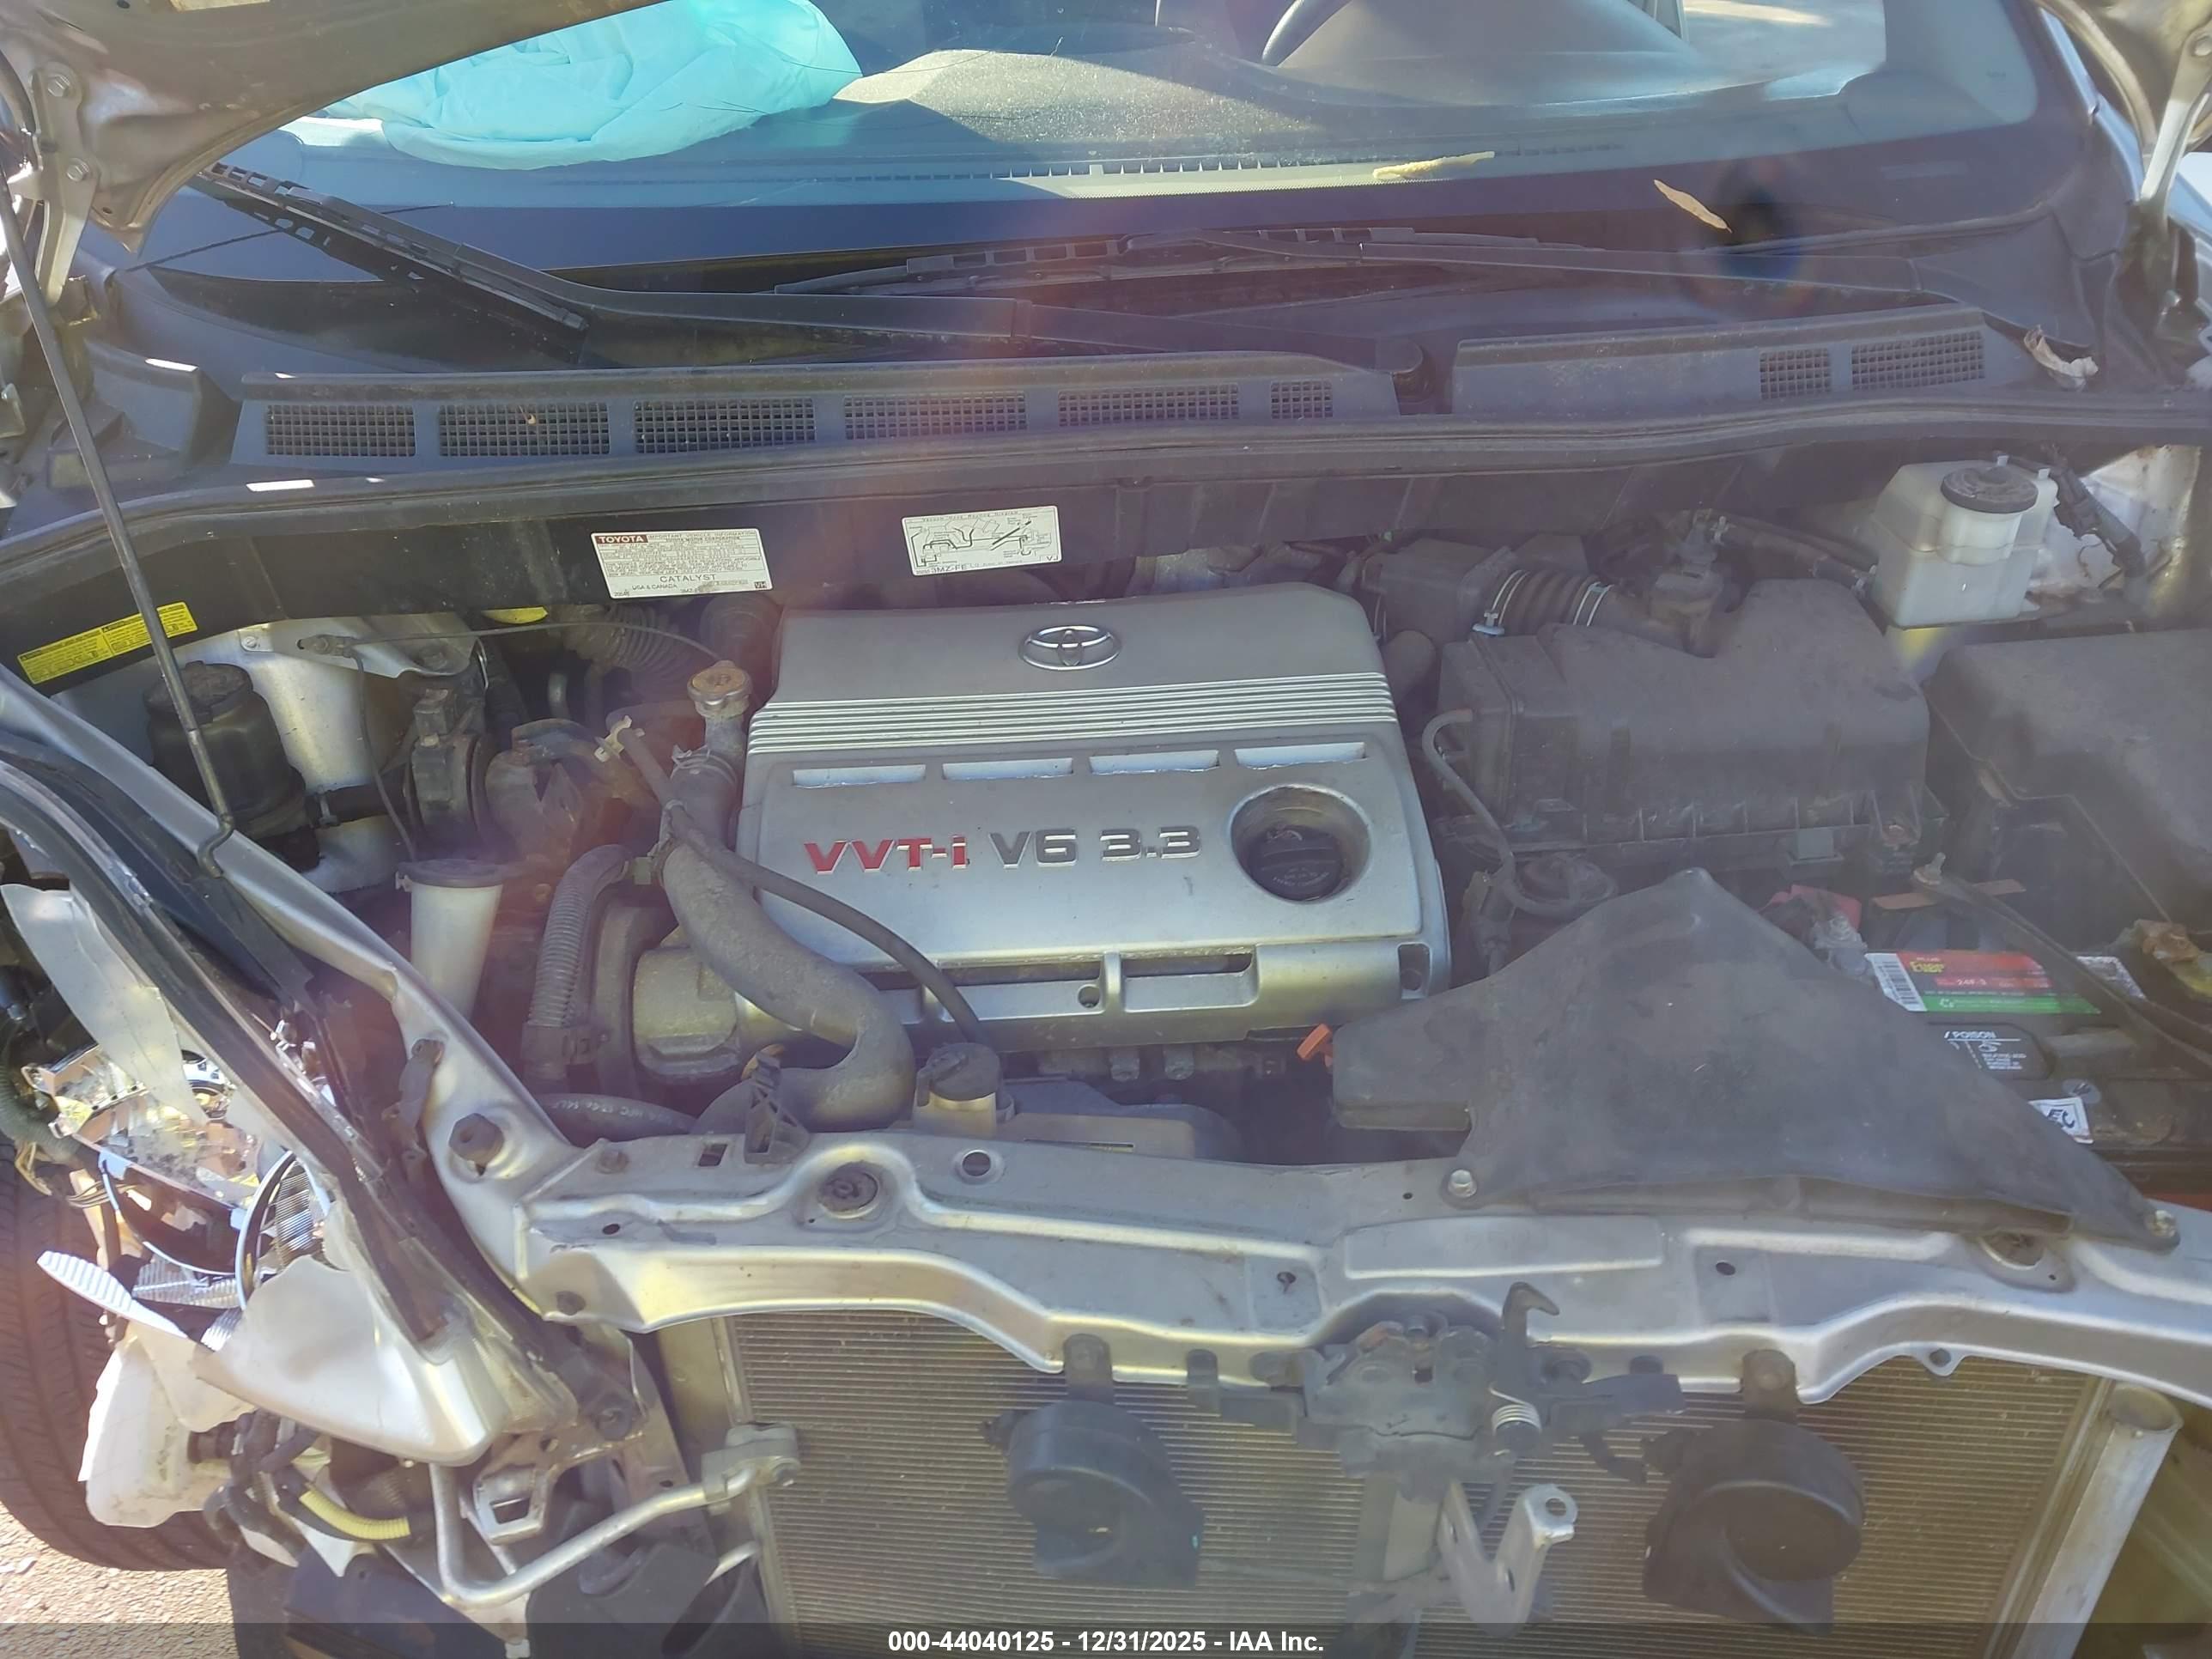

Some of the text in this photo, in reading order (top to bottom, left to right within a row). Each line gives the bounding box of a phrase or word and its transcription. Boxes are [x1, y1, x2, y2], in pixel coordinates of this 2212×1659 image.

[598, 535, 644, 544] TOYOTA
[659, 574, 717, 583] CATALYST
[803, 824, 1202, 874] VVT-i V6 3.3
